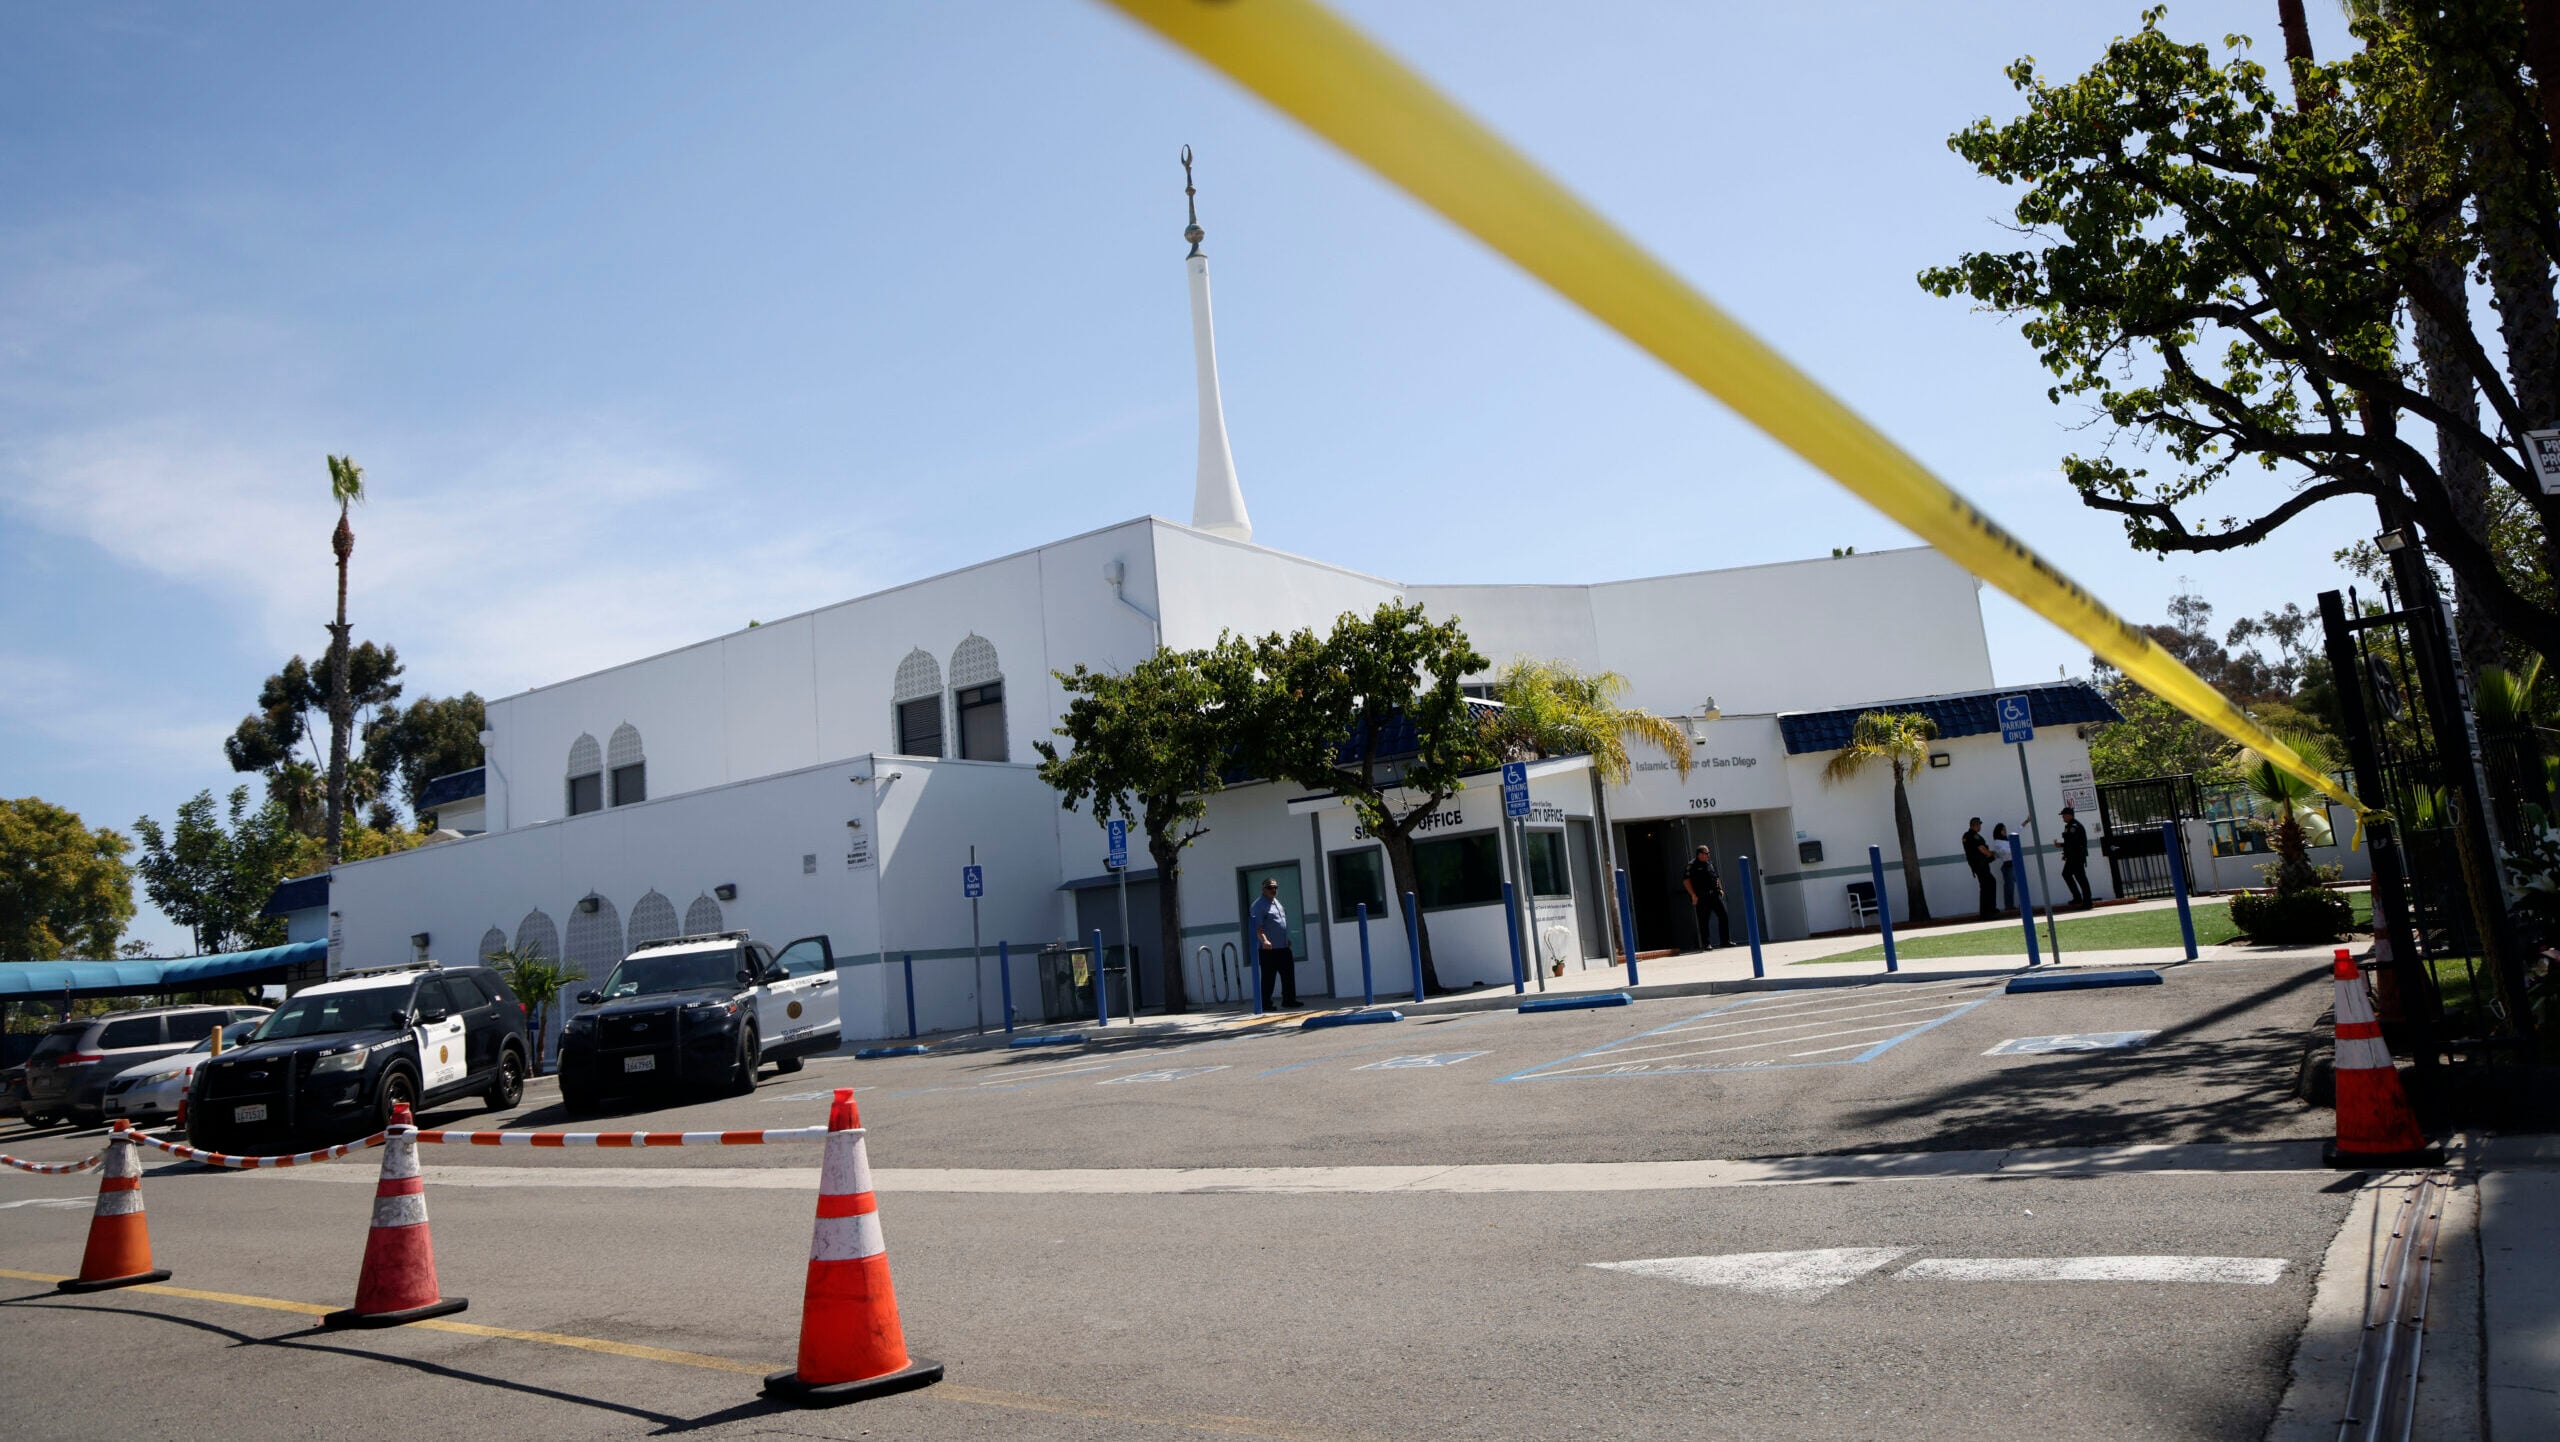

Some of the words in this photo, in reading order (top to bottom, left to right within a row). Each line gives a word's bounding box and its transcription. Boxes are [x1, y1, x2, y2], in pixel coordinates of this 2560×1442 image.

[2001, 719, 2031, 731] PARKING
[2009, 730, 2026, 741] ONLY
[1636, 761, 1669, 772] Islamic
[1701, 759, 1711, 768] of
[1713, 757, 1730, 768] San
[1731, 756, 1757, 768] Diego
[1505, 783, 1527, 793] PARKING
[1510, 792, 1524, 801] ONLY
[1689, 798, 1716, 809] 7050
[1418, 810, 1463, 831] OFFICE
[1543, 808, 1564, 823] OFFICE
